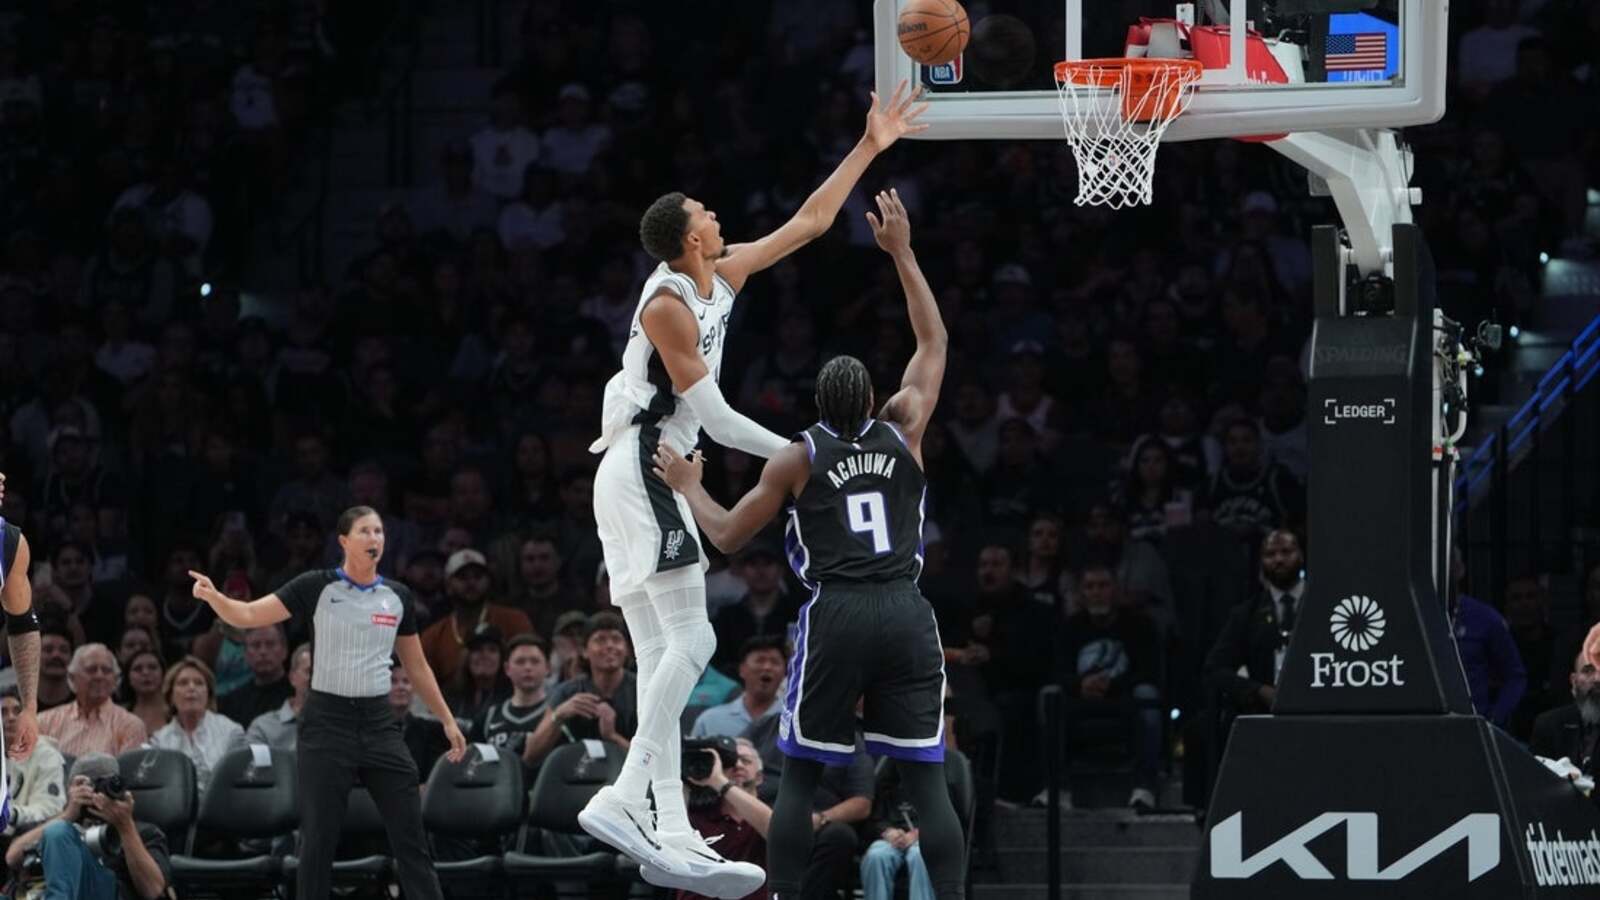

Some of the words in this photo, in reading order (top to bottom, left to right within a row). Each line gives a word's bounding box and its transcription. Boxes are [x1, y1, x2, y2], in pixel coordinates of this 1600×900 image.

[933, 66, 951, 79] NBA
[1334, 405, 1386, 418] LEDGER
[827, 452, 896, 489] ACHIUWA
[845, 491, 892, 555] 9
[1310, 652, 1405, 687] Frost
[1210, 810, 1501, 883] KIA
